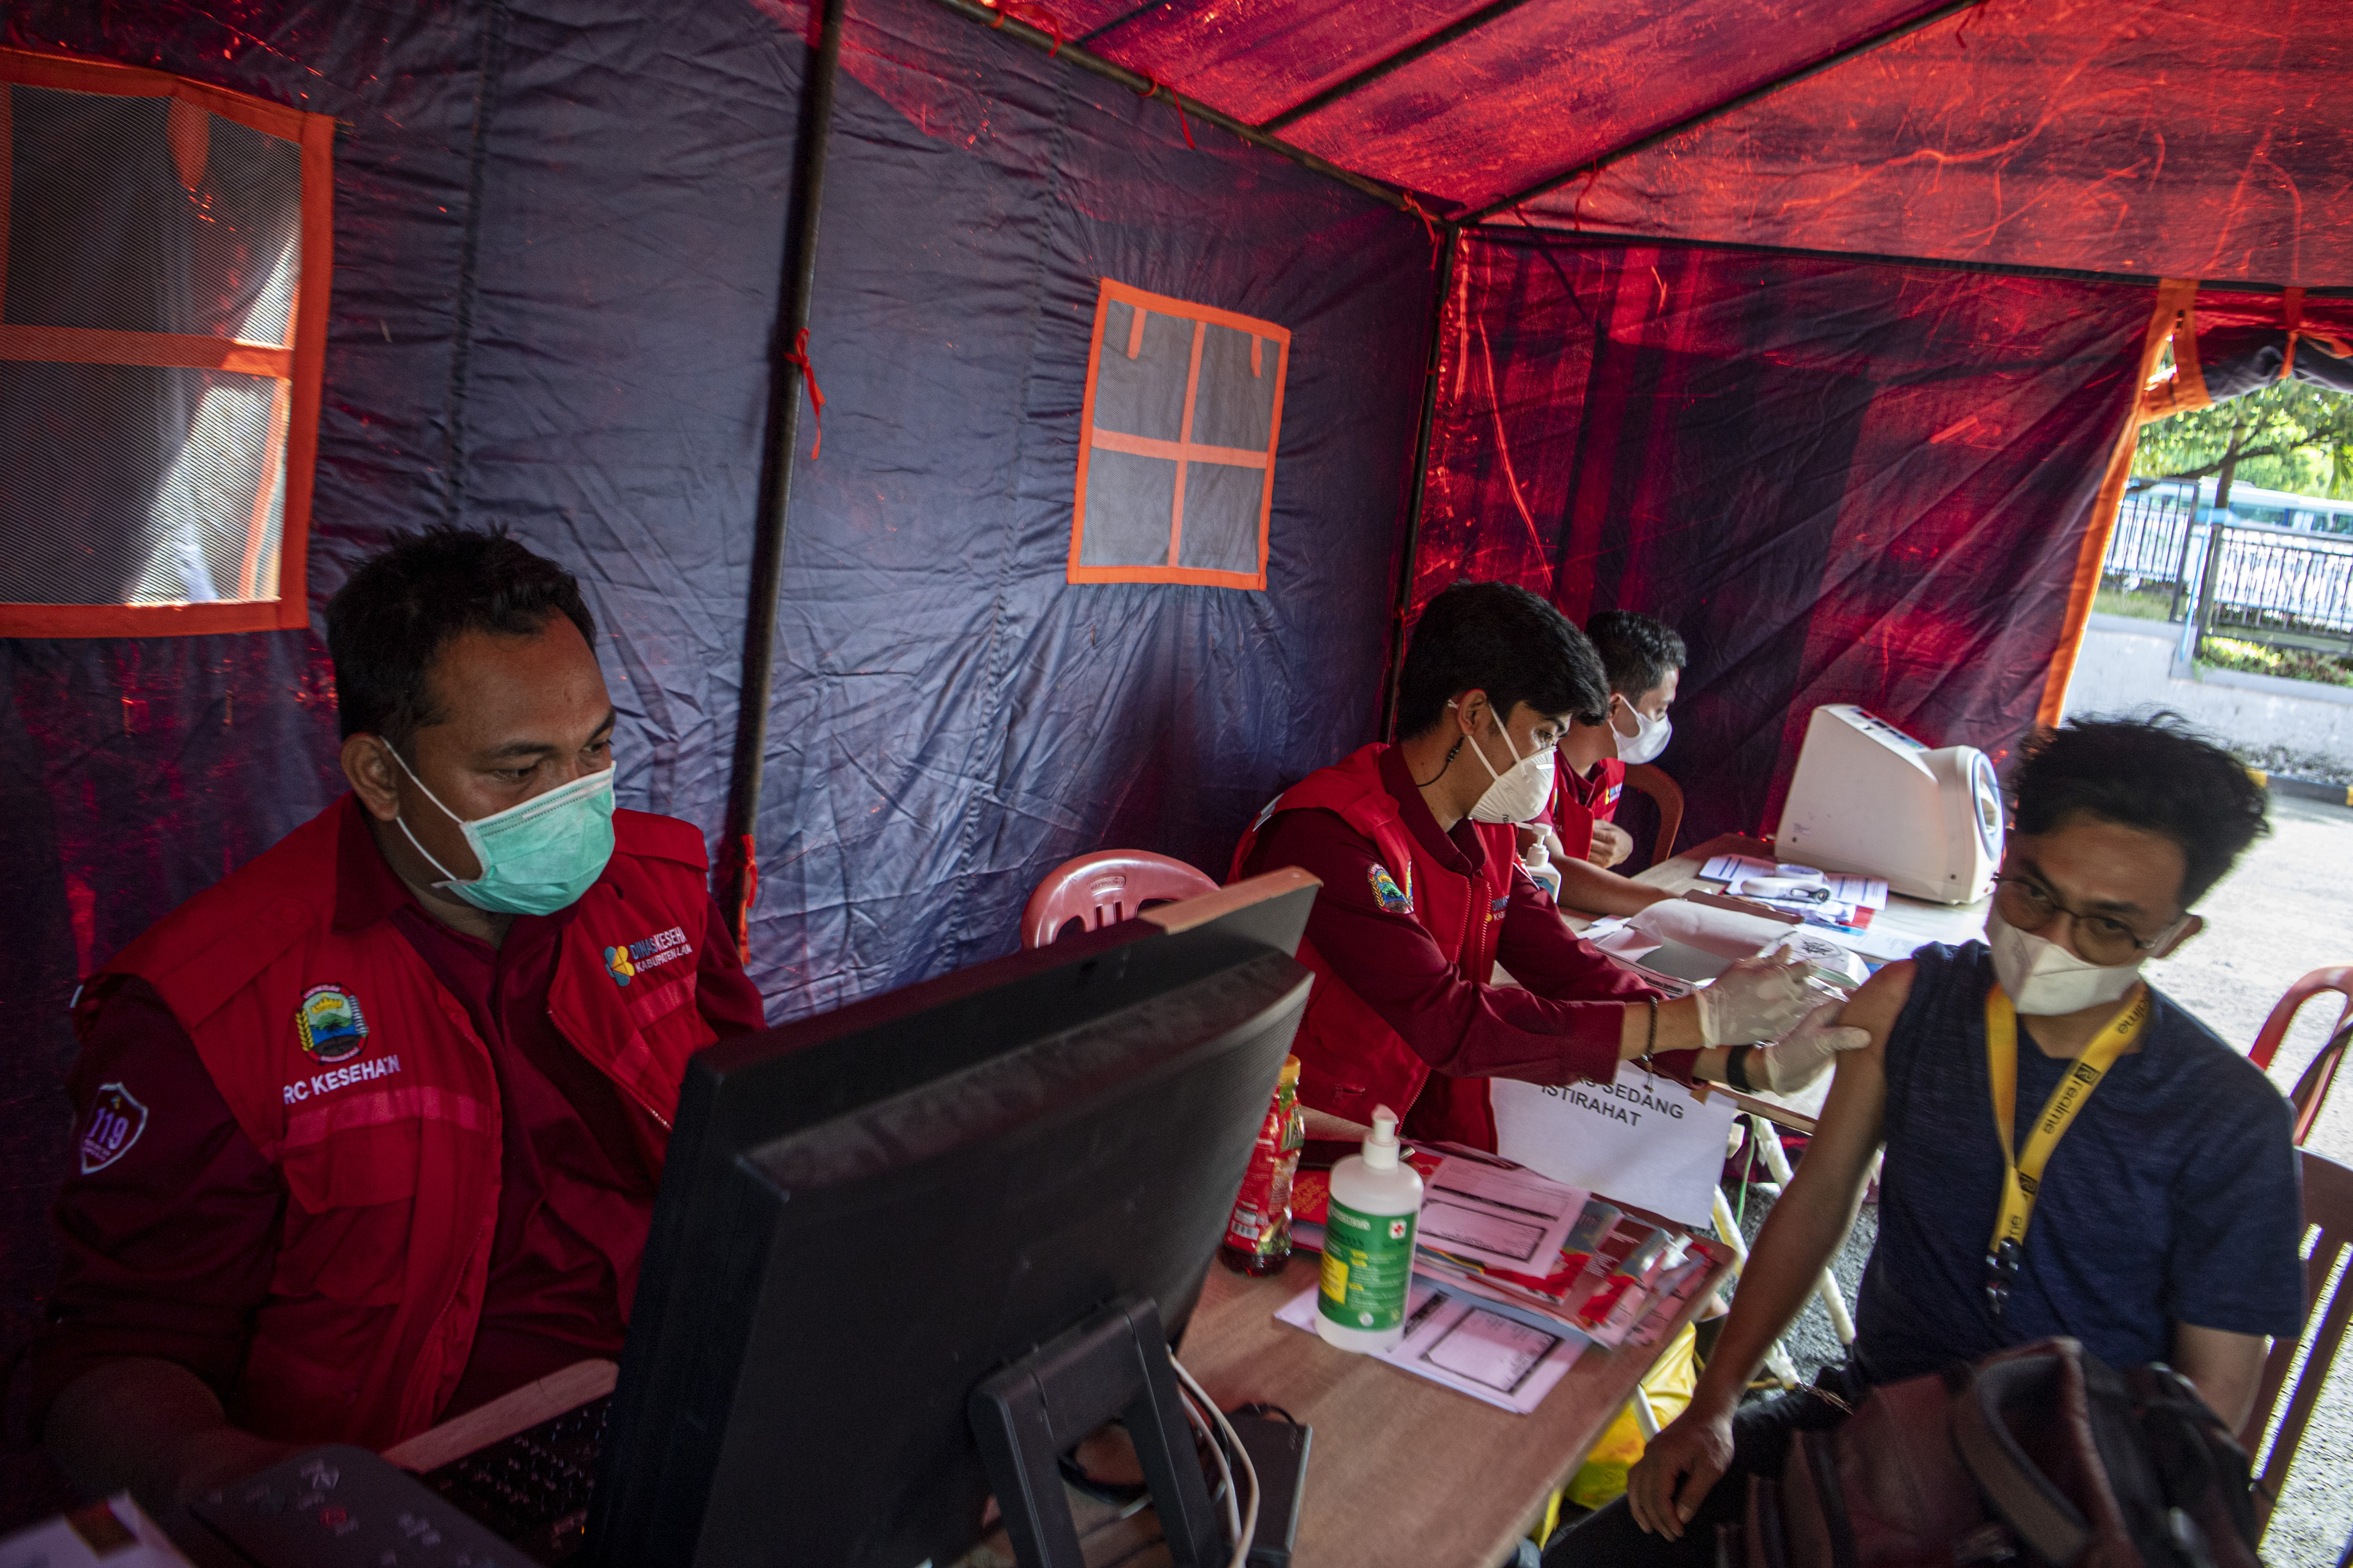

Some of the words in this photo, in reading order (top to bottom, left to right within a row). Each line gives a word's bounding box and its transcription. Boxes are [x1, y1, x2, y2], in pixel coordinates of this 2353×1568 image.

[634, 948, 677, 973] KABUPATEN
[1541, 1085, 1642, 1127] ISTIRAHAT
[1602, 1083, 1684, 1119] SEDANG
[2043, 1079, 2084, 1135] realme
[87, 1106, 129, 1150] 119
